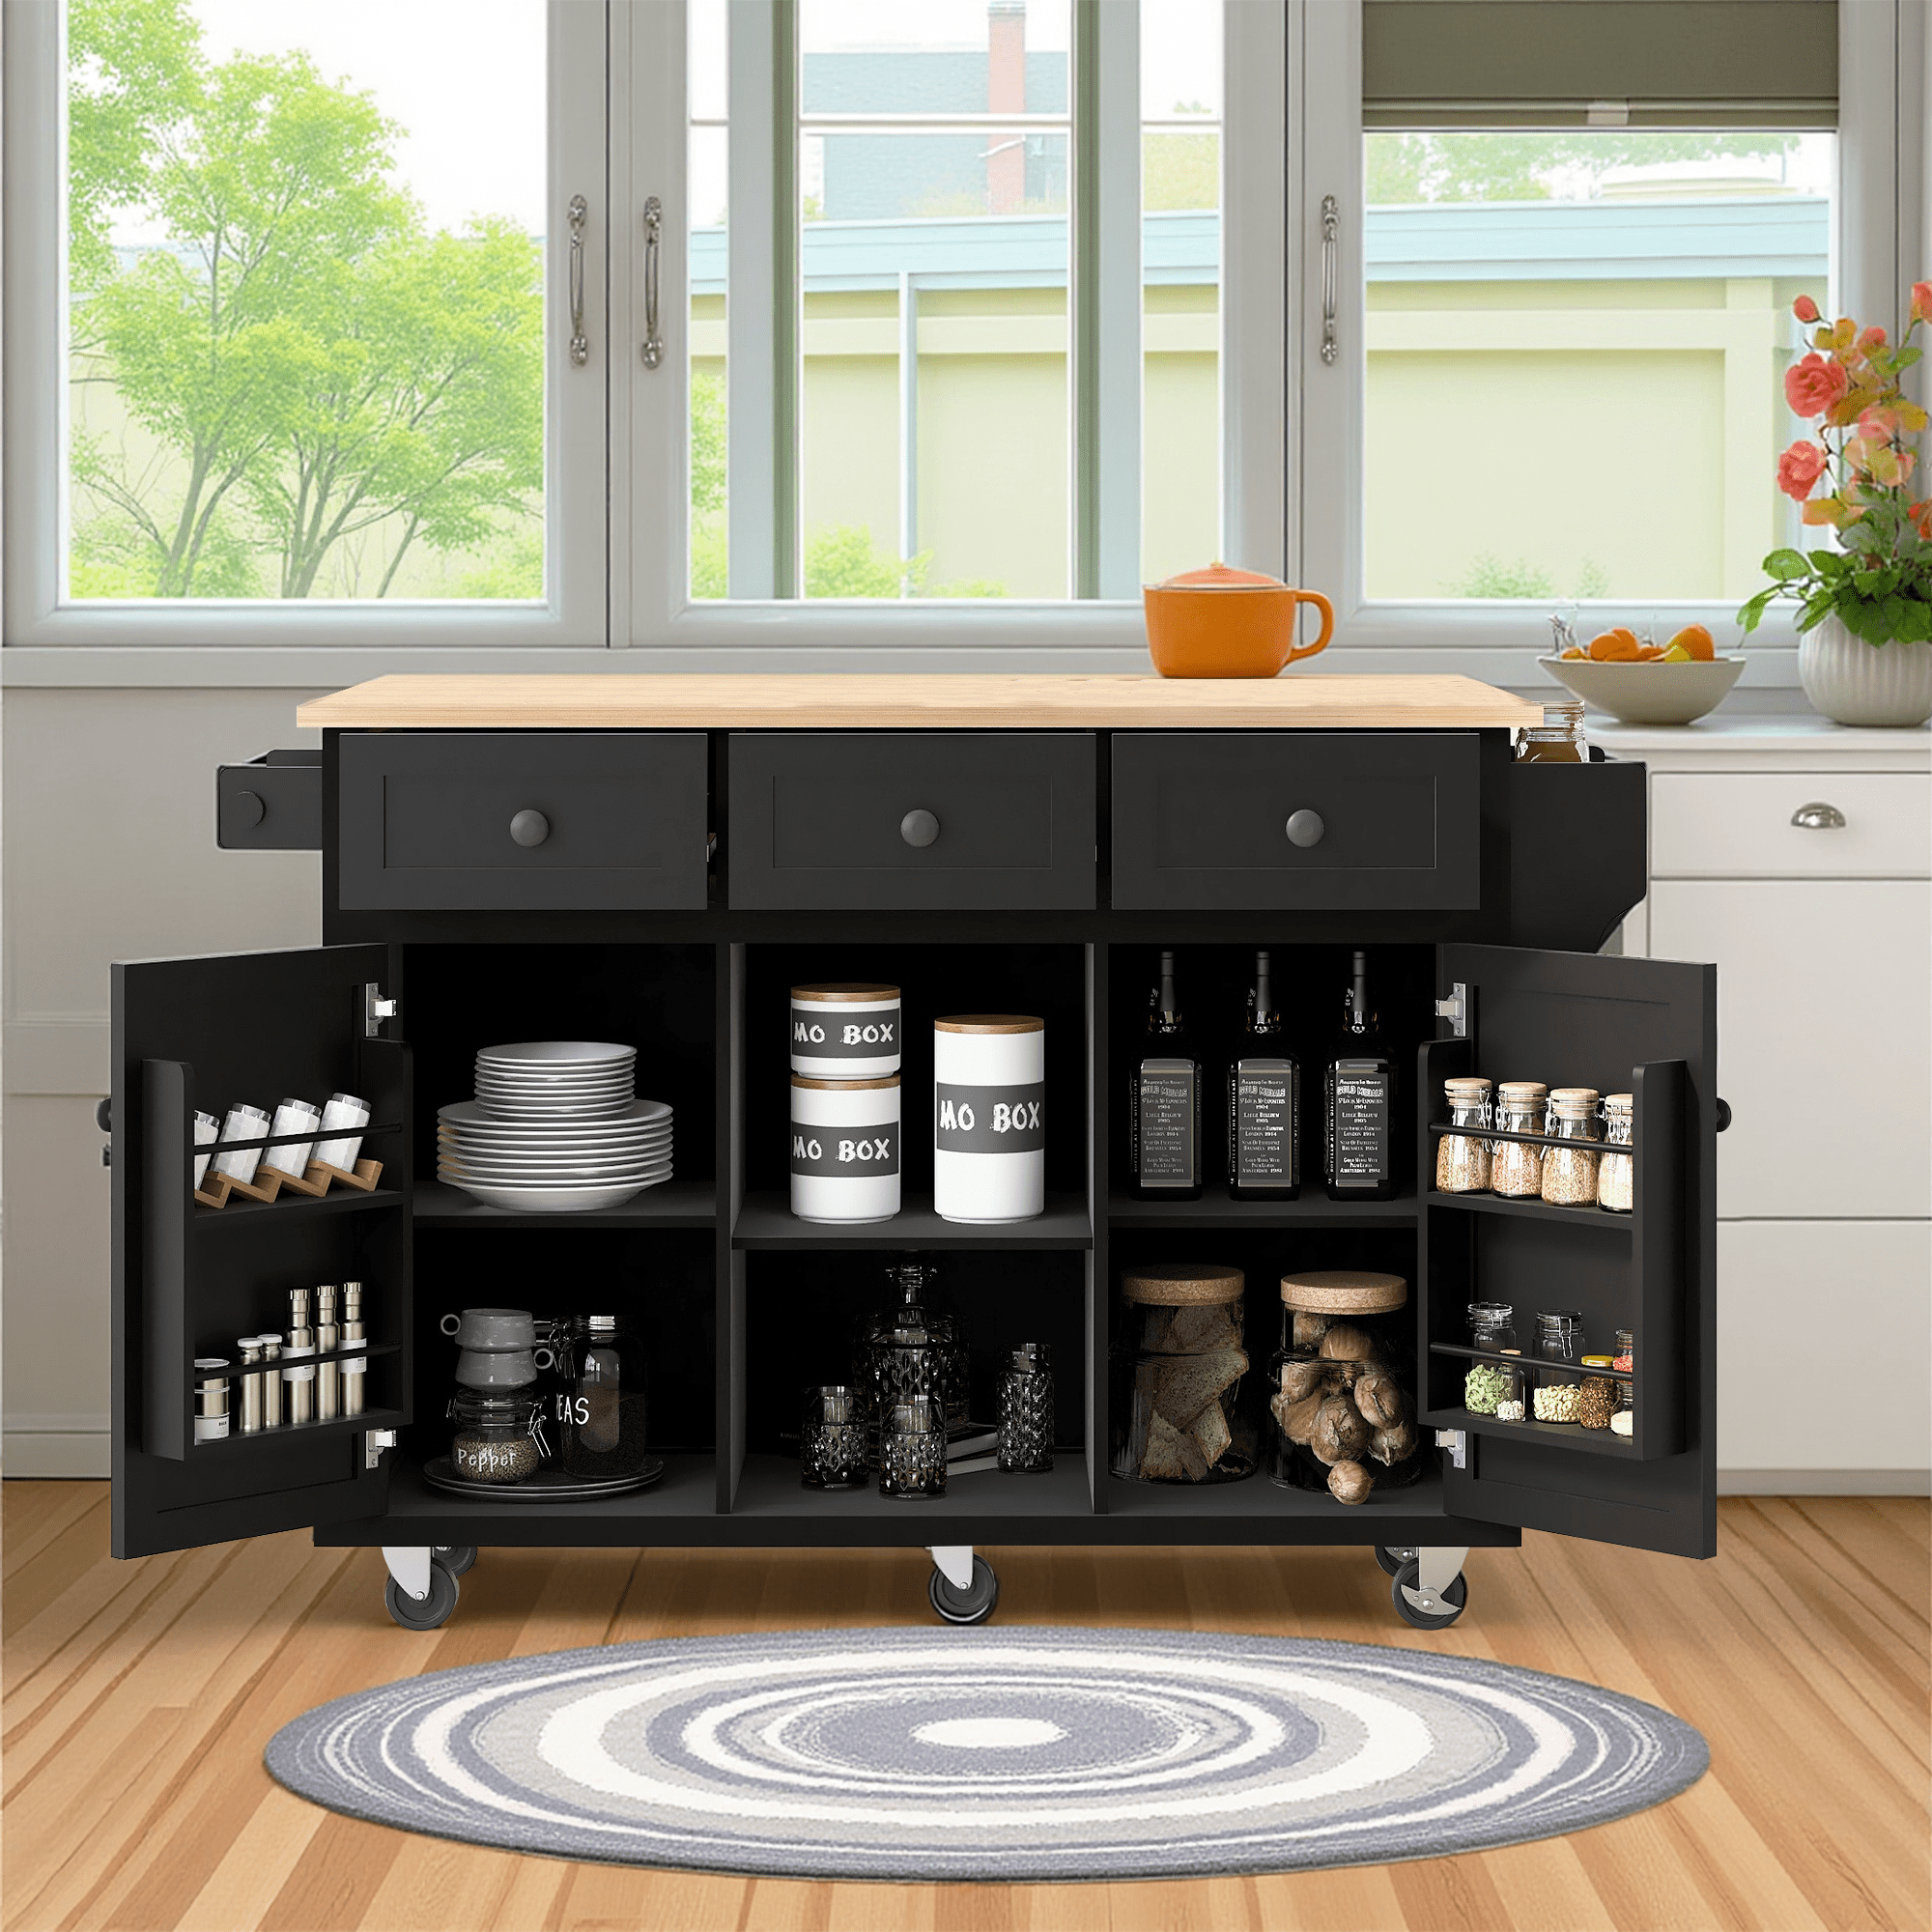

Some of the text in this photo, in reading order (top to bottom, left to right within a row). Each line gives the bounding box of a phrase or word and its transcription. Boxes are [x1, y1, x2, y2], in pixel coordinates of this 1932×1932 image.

[793, 1022, 894, 1045] MO BOX
[940, 1099, 1040, 1133] MO BOX
[793, 1135, 891, 1163] MO BOX
[457, 1448, 517, 1473] Pepper
